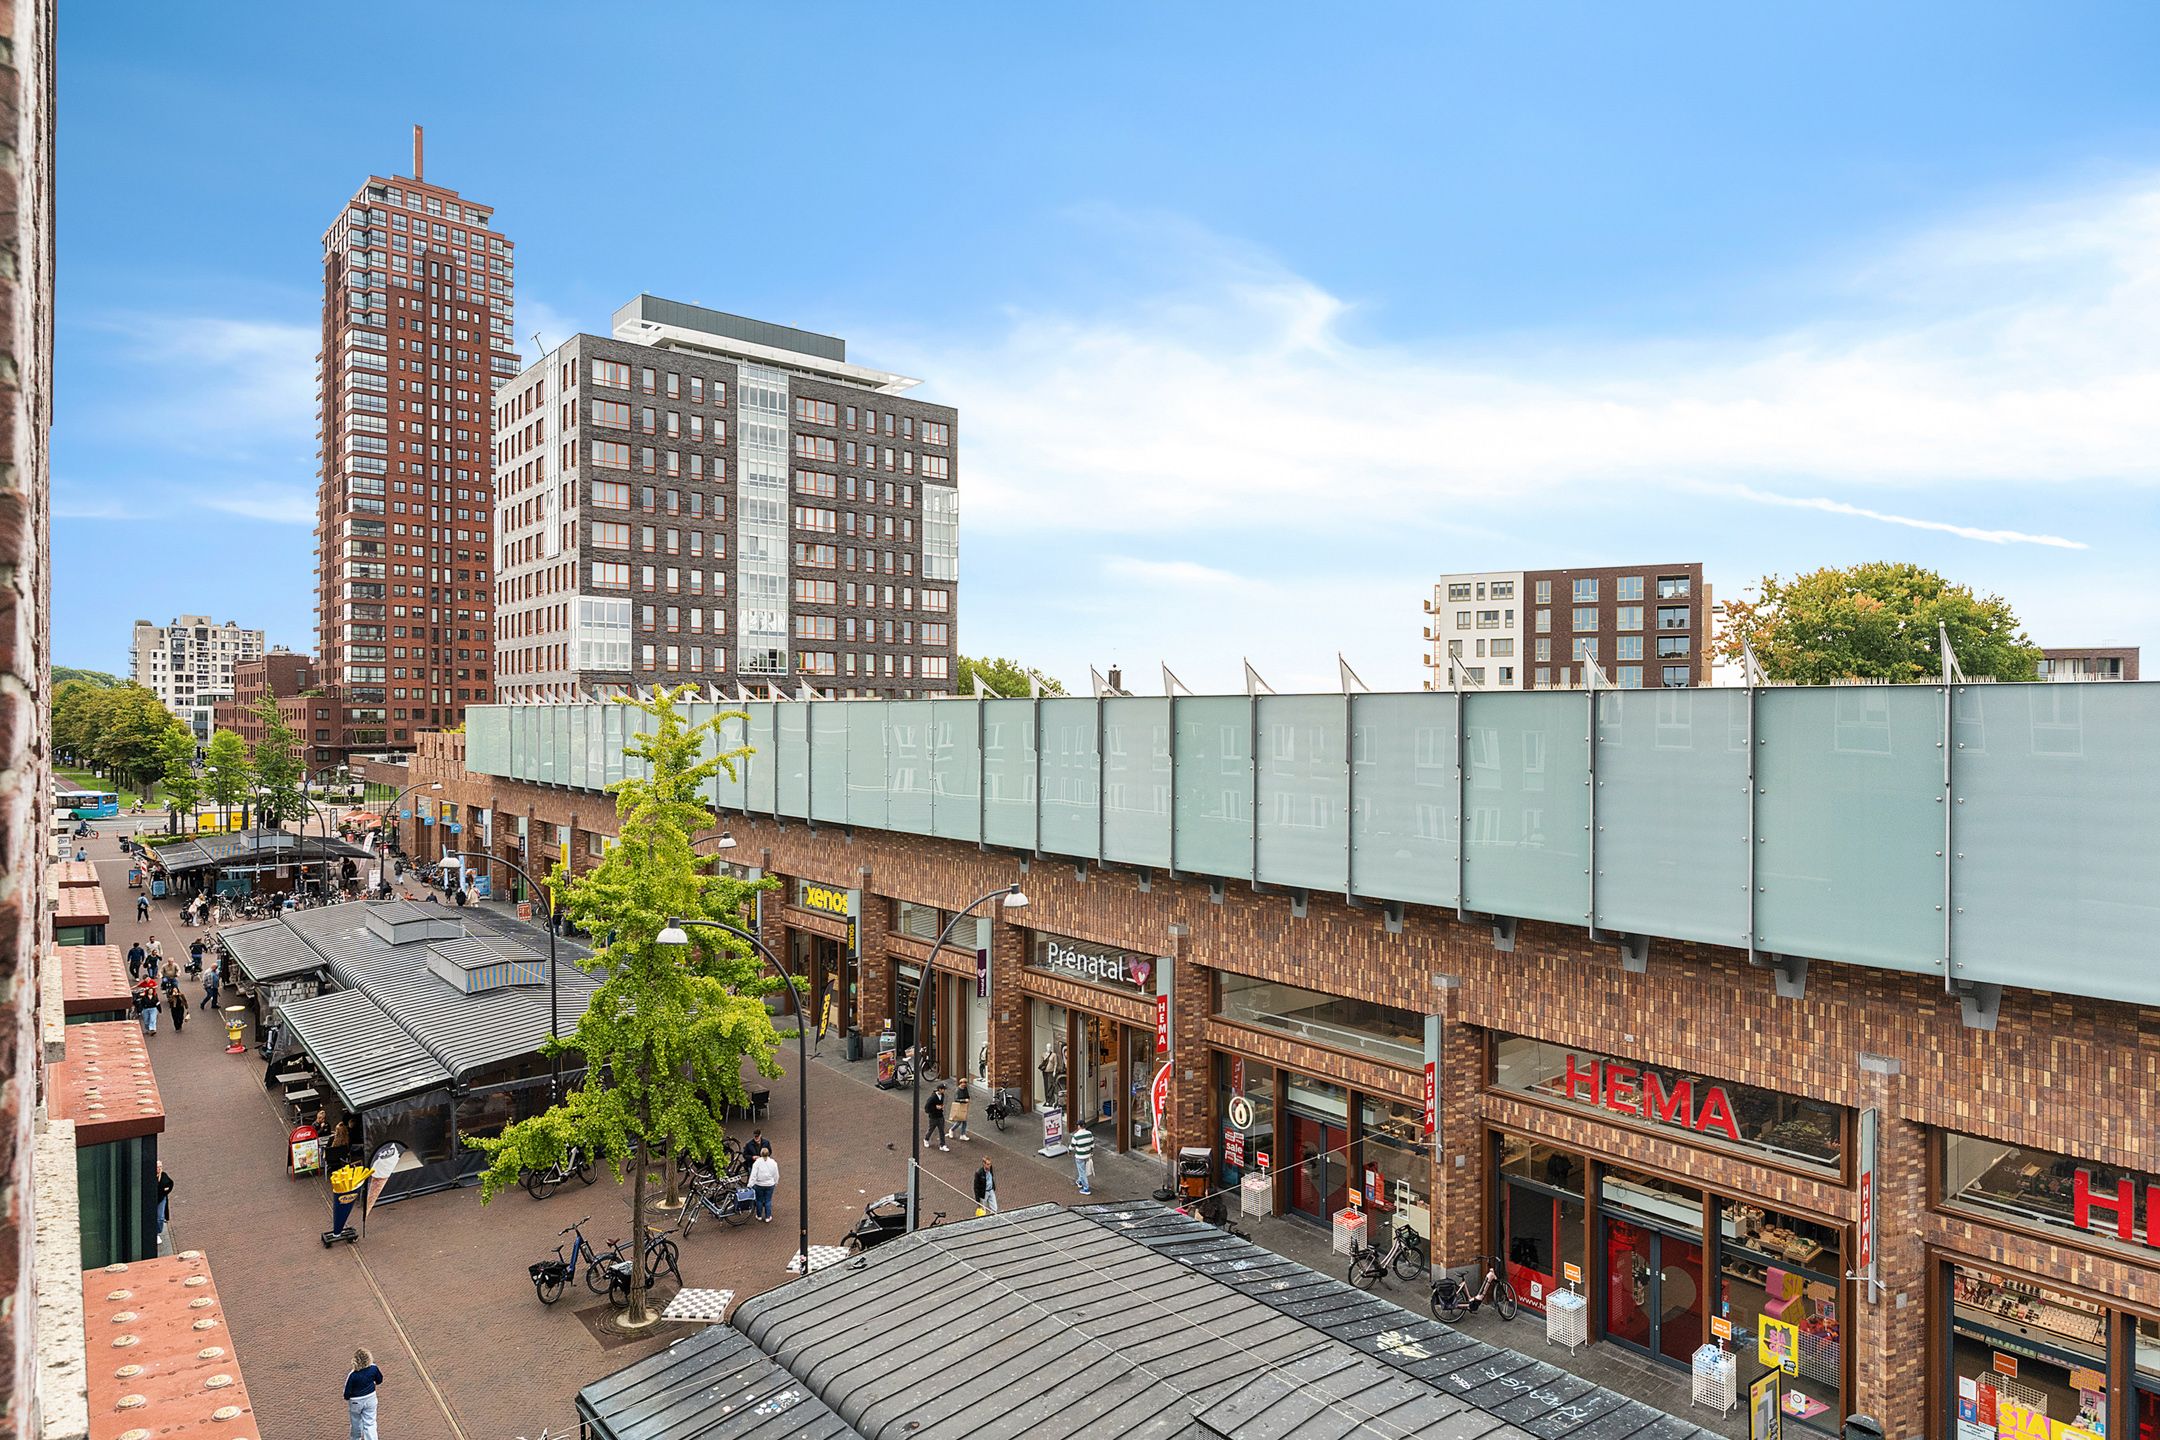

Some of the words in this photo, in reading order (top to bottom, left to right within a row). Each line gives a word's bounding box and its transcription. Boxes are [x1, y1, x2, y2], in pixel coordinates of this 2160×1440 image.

[806, 885, 848, 914] xenos
[1048, 942, 1125, 981] Prénatal
[820, 993, 831, 1036] xenos
[1158, 1002, 1167, 1045] HEMA
[1426, 1071, 1434, 1125] HEMA
[1566, 1053, 1743, 1140] HEMA
[1226, 1142, 1243, 1154] sale
[1999, 1402, 2050, 1438] STA
